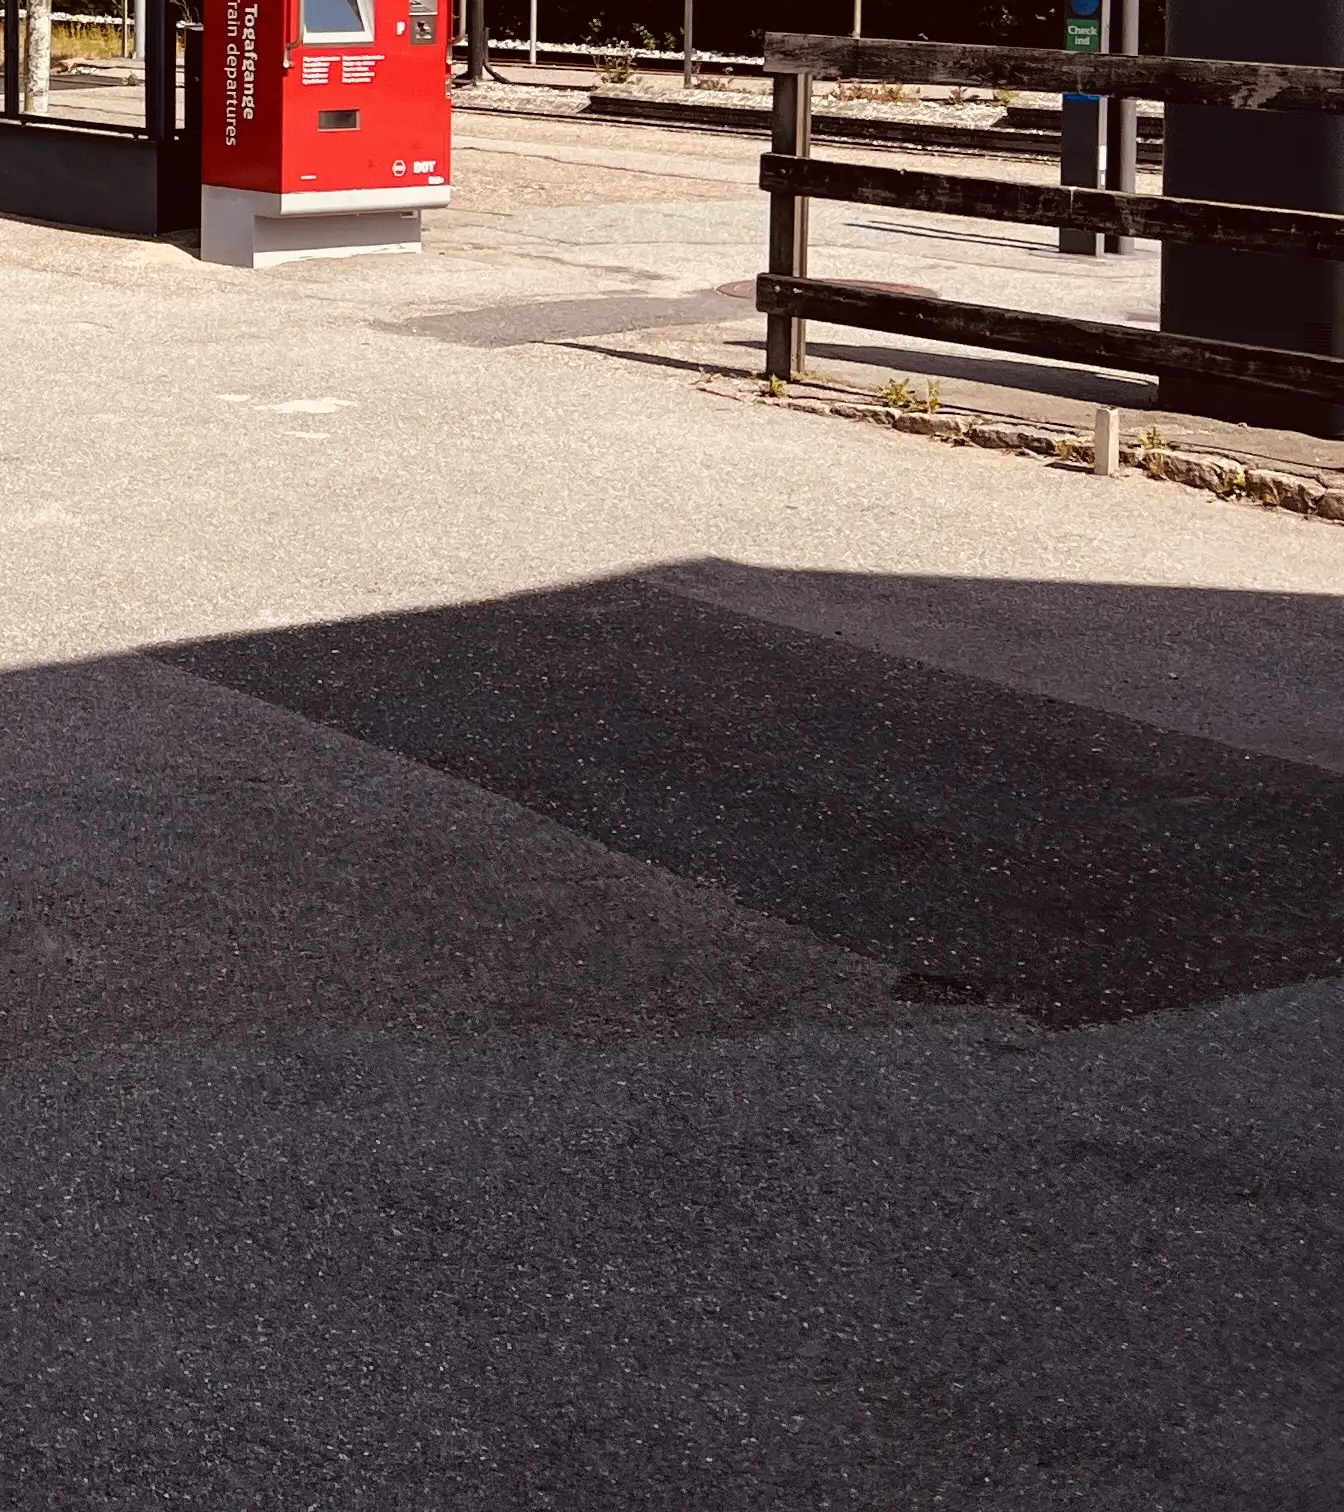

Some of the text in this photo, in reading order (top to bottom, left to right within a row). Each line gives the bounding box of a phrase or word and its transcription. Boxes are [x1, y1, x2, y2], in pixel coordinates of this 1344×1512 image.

[241, 3, 258, 120] Togafgange
[1067, 25, 1098, 36] Check
[223, 43, 241, 146] departures
